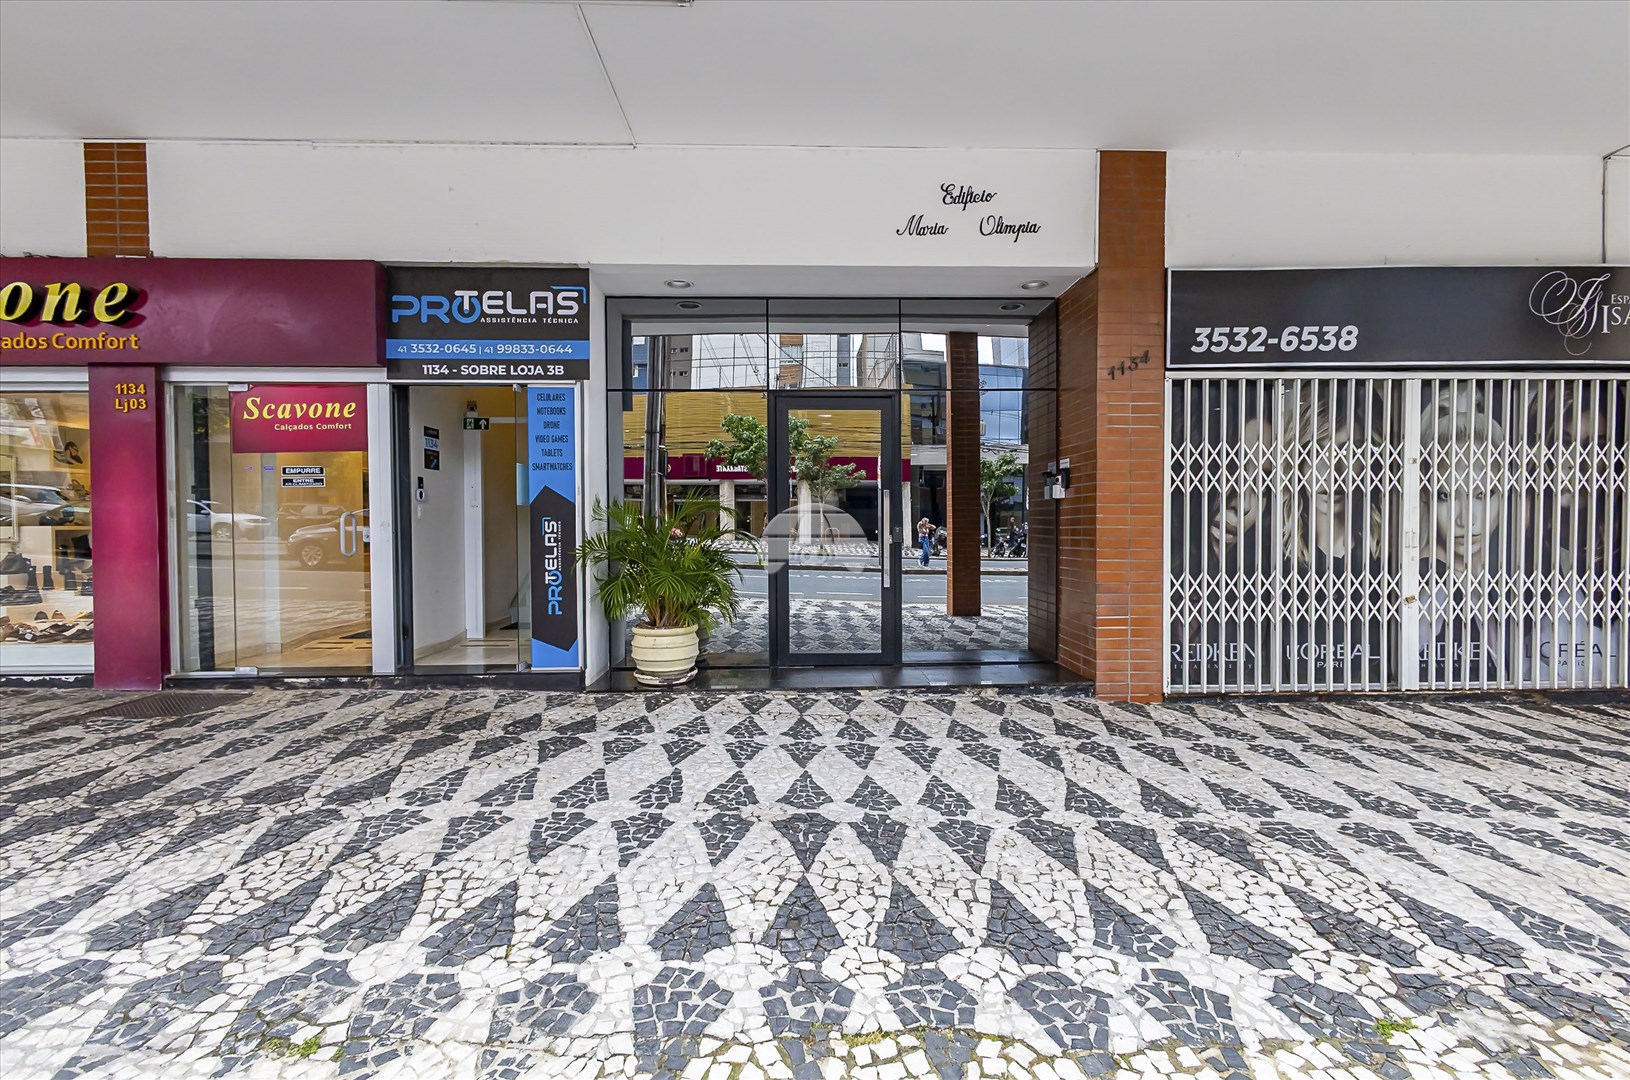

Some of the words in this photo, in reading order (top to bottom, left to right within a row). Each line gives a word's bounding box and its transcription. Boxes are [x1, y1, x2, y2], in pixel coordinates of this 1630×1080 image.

[896, 214, 949, 236] Maria
[391, 290, 579, 324] PROTELAS
[480, 316, 537, 324] ASSISTÊNCIA
[542, 316, 579, 324] TÉCNICA
[52, 332, 139, 349] Comfort
[1190, 325, 1359, 353] 3532-6538
[410, 343, 477, 354] 3532-0645
[484, 345, 494, 354] 41
[496, 343, 573, 354] 99833-0644
[422, 364, 449, 375] 1134
[460, 364, 507, 376] SOBRE
[510, 364, 545, 376] LOJA
[547, 364, 565, 376] 3B
[115, 383, 145, 395] 1134
[536, 393, 566, 402] CELULARES
[115, 398, 146, 413] Lj03
[243, 397, 356, 420] Scavone
[536, 407, 567, 416] NOTEBOOKS
[274, 423, 314, 431] Calçados
[316, 422, 352, 430] Comfort
[543, 420, 561, 430] DRONE
[535, 434, 550, 444] VIDEO
[551, 434, 569, 444] GAMES
[541, 448, 563, 457] TABLETS
[532, 463, 572, 471] SMARTWATCHES
[544, 521, 563, 615] PROTELAS
